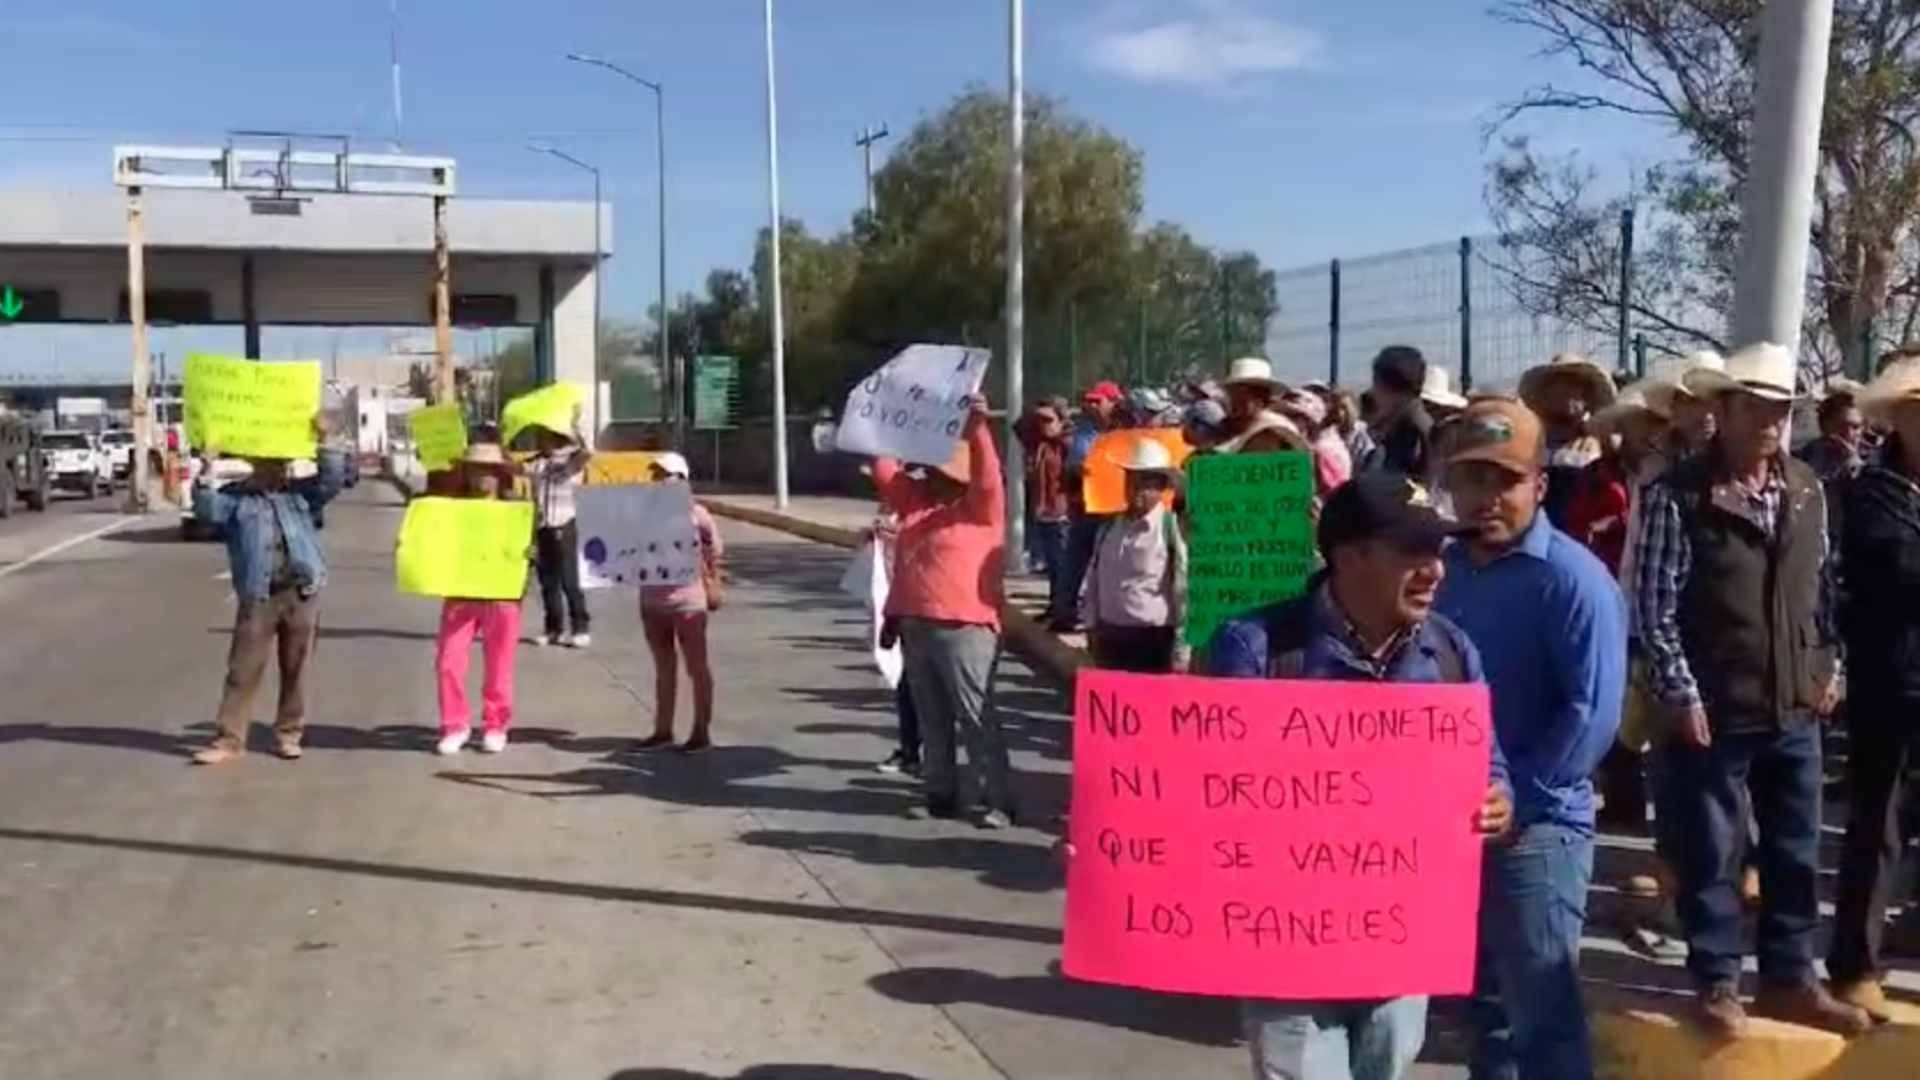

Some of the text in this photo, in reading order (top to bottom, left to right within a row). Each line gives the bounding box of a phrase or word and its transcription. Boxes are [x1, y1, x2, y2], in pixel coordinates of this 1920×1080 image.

[1088, 690, 1486, 749] NO MAS AVIONETAS
[1110, 766, 1374, 810] NI DRONES
[1098, 828, 1418, 876] QUE SE VAYAN
[1125, 894, 1409, 949] LOS PANELES
